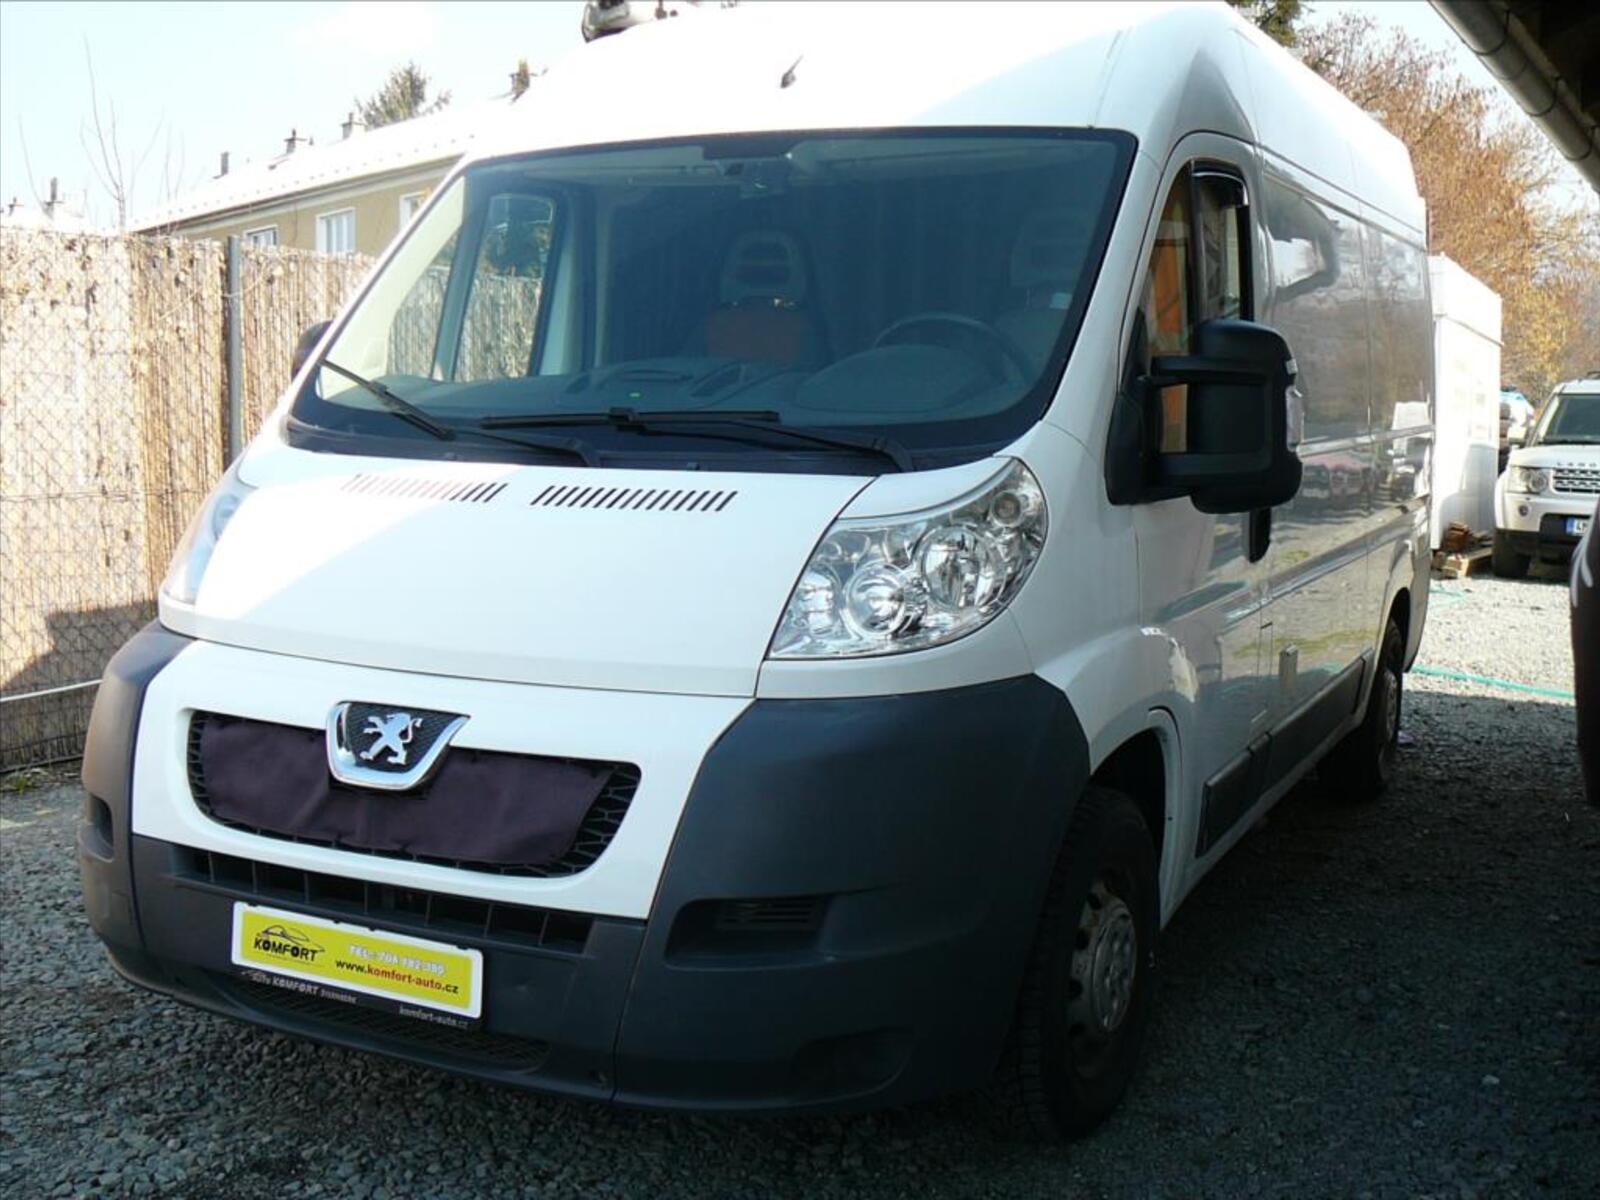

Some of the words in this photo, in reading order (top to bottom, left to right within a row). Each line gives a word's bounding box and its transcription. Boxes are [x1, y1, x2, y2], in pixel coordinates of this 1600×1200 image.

[254, 937, 318, 962] KOMFORT
[272, 975, 319, 994] KOMFORT
[335, 960, 459, 994] www.komfort-auto.cz
